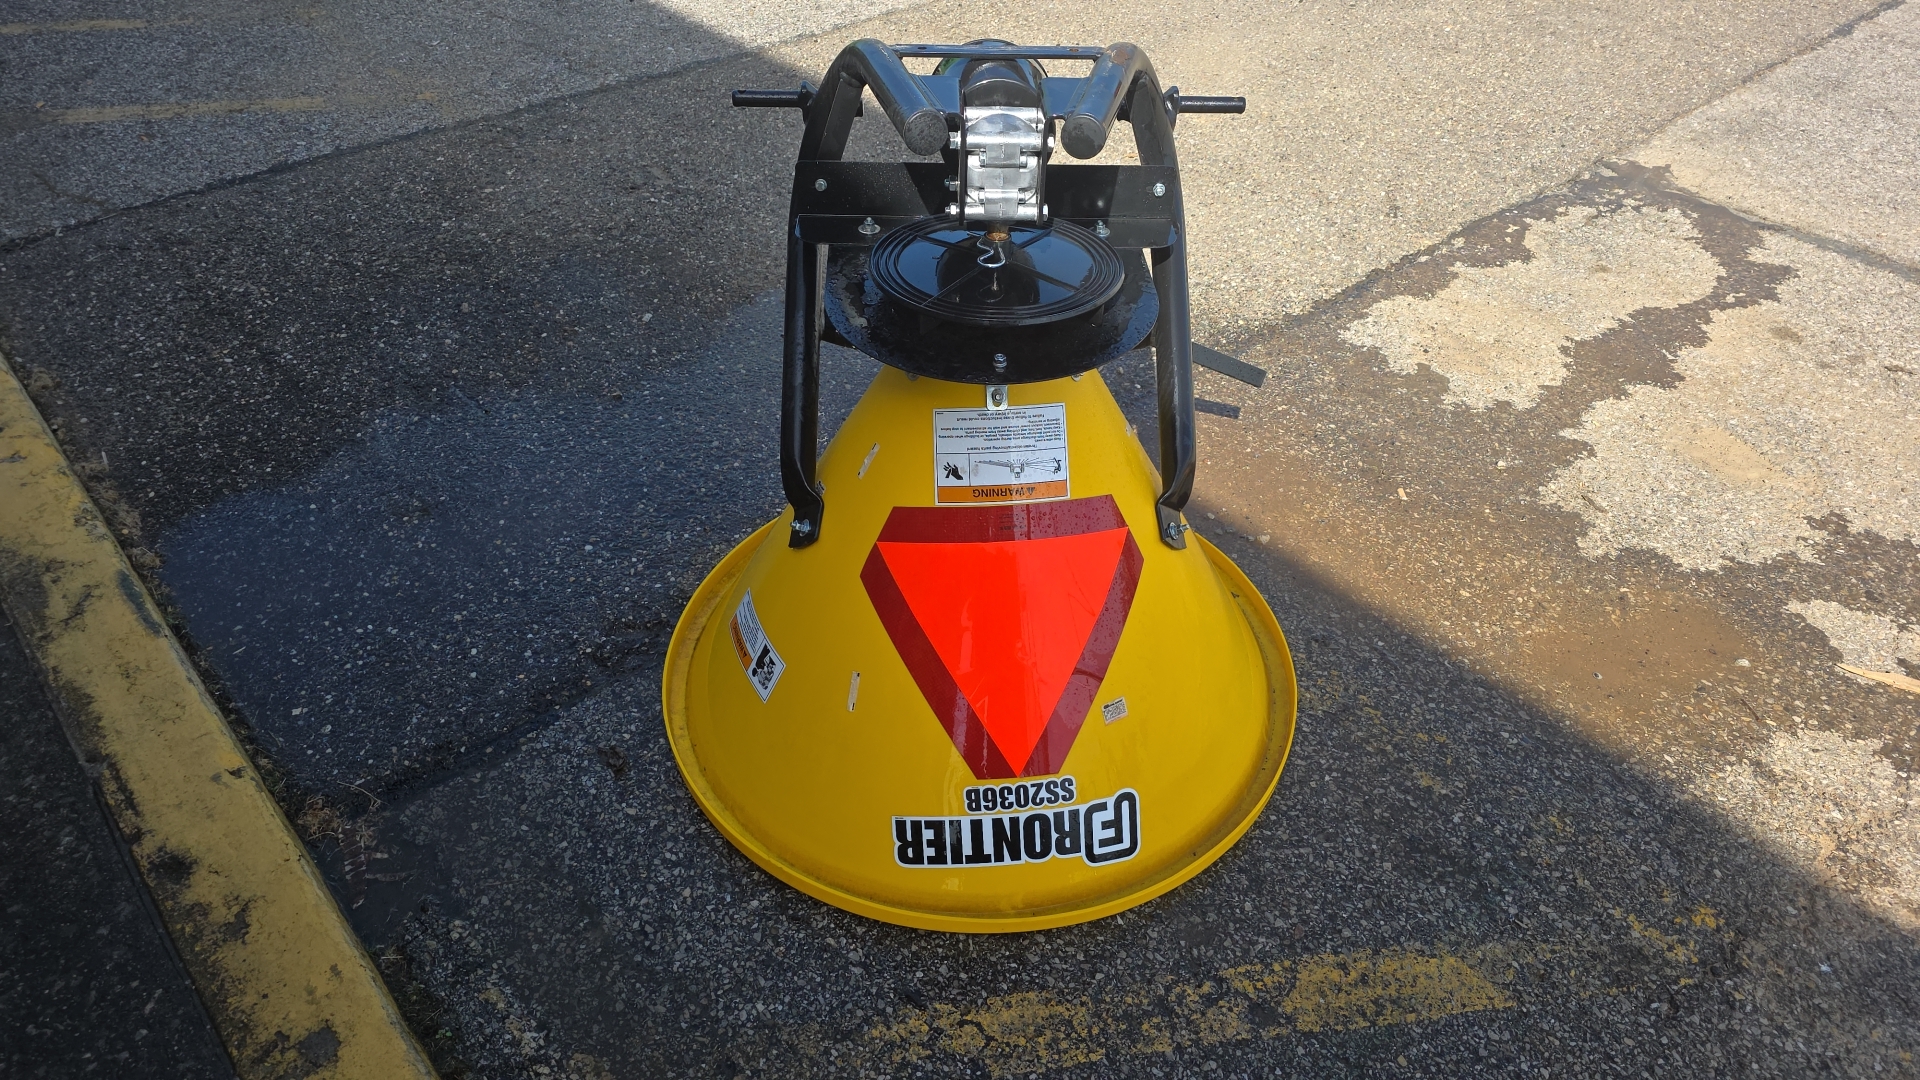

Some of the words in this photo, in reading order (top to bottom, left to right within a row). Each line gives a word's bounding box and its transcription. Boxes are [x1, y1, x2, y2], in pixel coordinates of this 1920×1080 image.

[972, 487, 1025, 498] WARNING
[965, 780, 1074, 812] SS2036B
[895, 791, 1139, 864] FRONTIER
